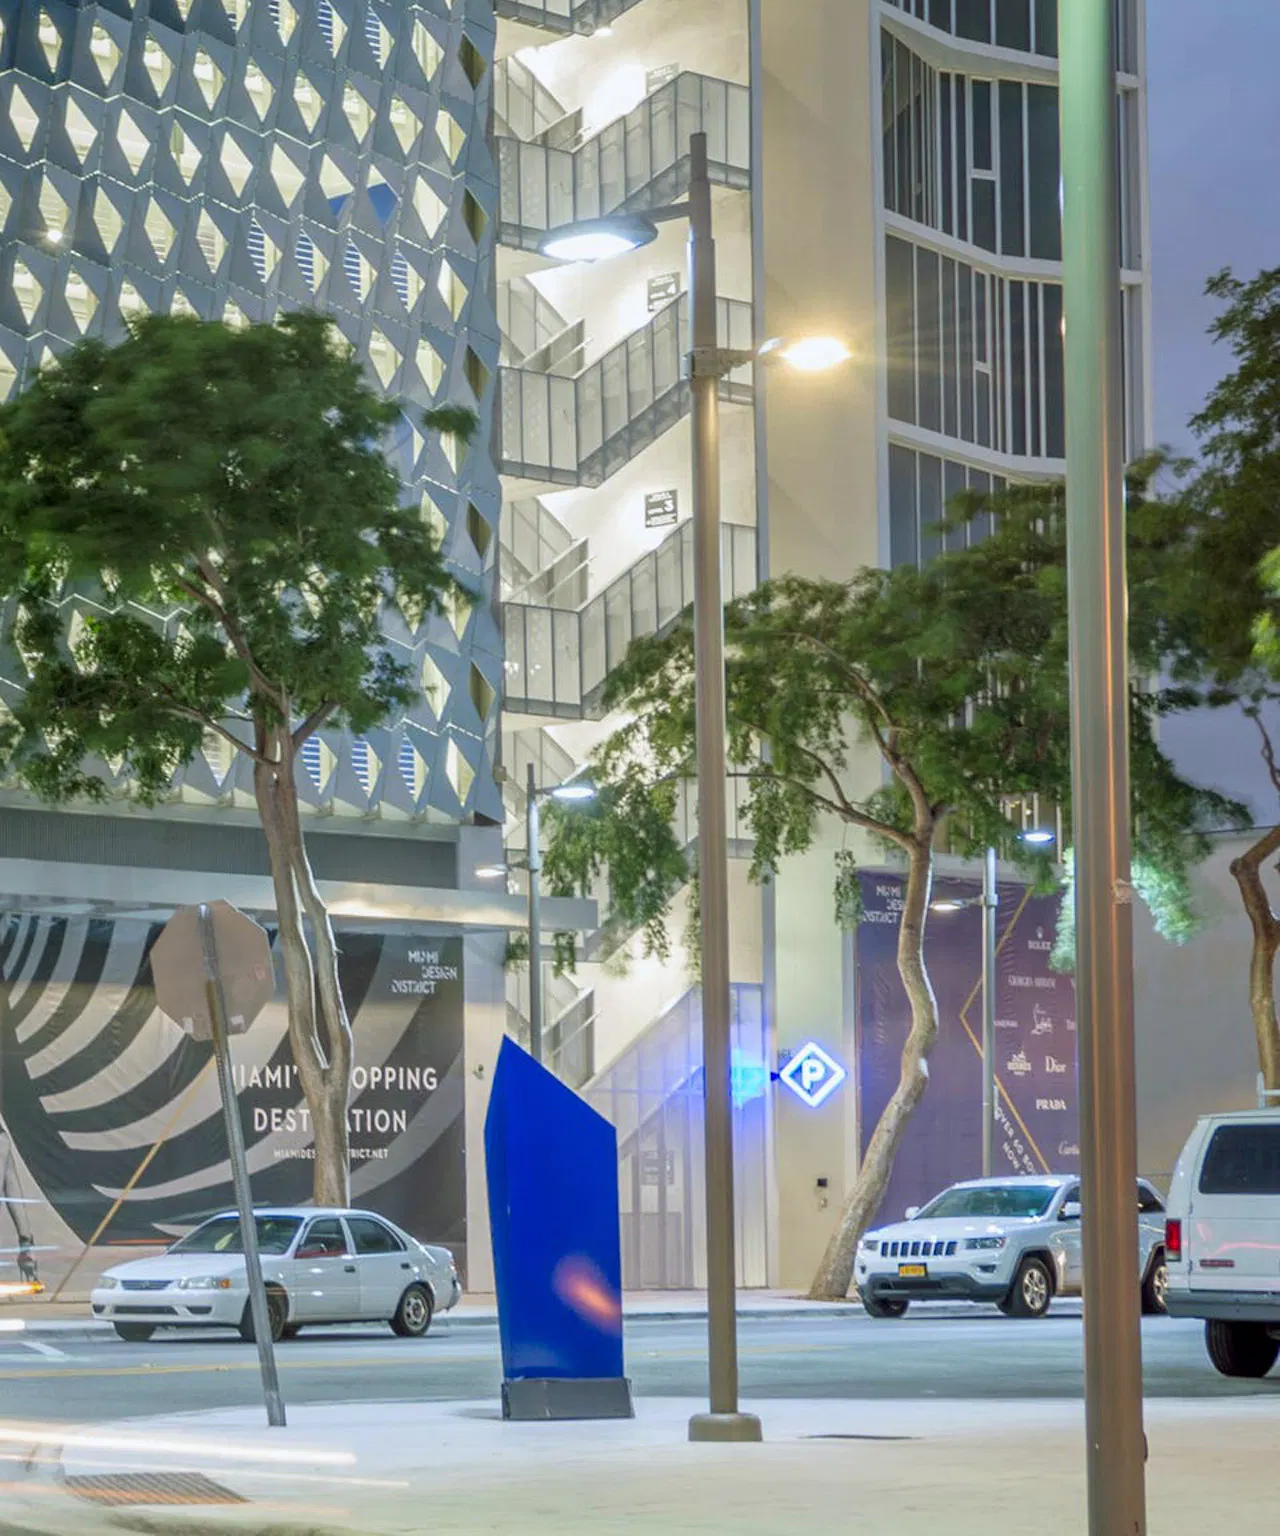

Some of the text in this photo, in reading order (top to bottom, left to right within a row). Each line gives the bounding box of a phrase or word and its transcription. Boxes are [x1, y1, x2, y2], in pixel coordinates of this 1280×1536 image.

[232, 1064, 438, 1091] IAMI' OPPING
[253, 1108, 407, 1133] DESTTION
